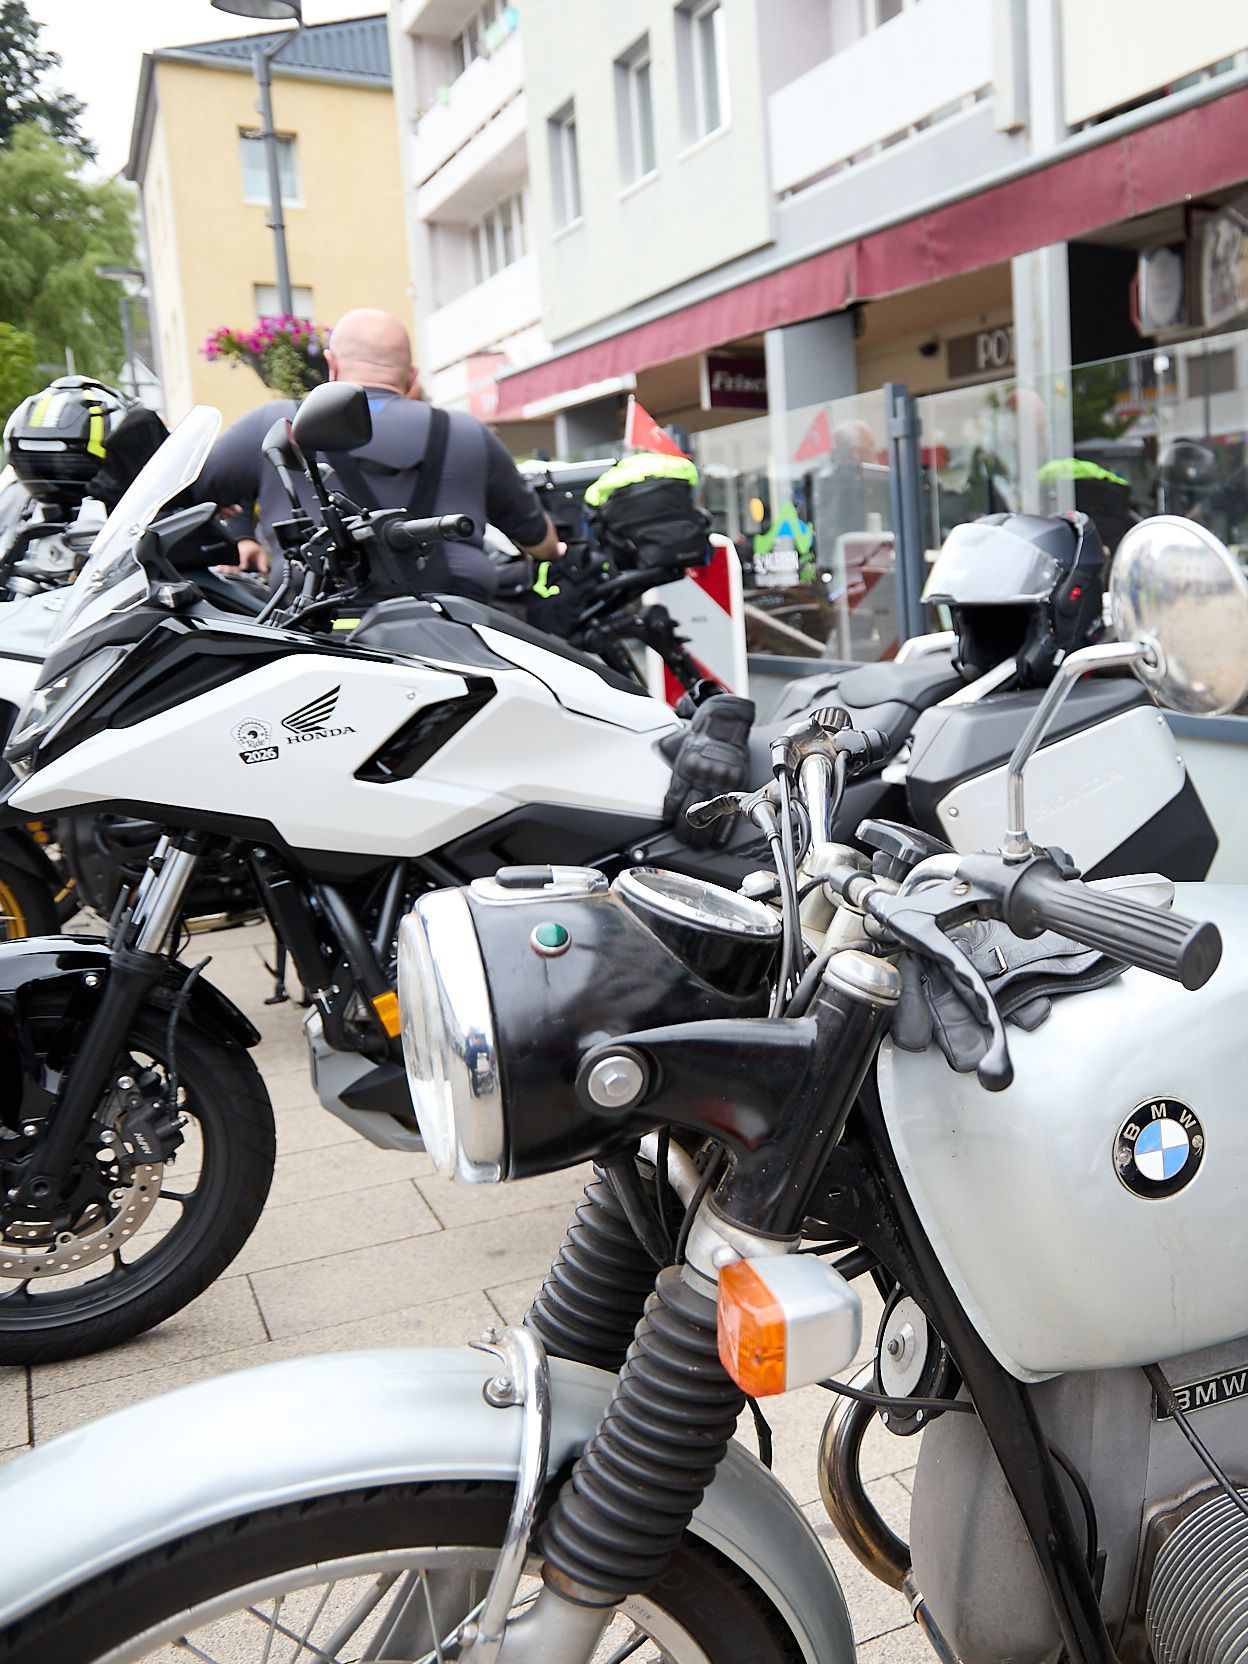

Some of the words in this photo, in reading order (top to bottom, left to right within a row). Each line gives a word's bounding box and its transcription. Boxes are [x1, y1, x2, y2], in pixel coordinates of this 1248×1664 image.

[286, 726, 357, 745] HONDA
[243, 747, 278, 763] 2026
[1122, 1102, 1197, 1141] BMW
